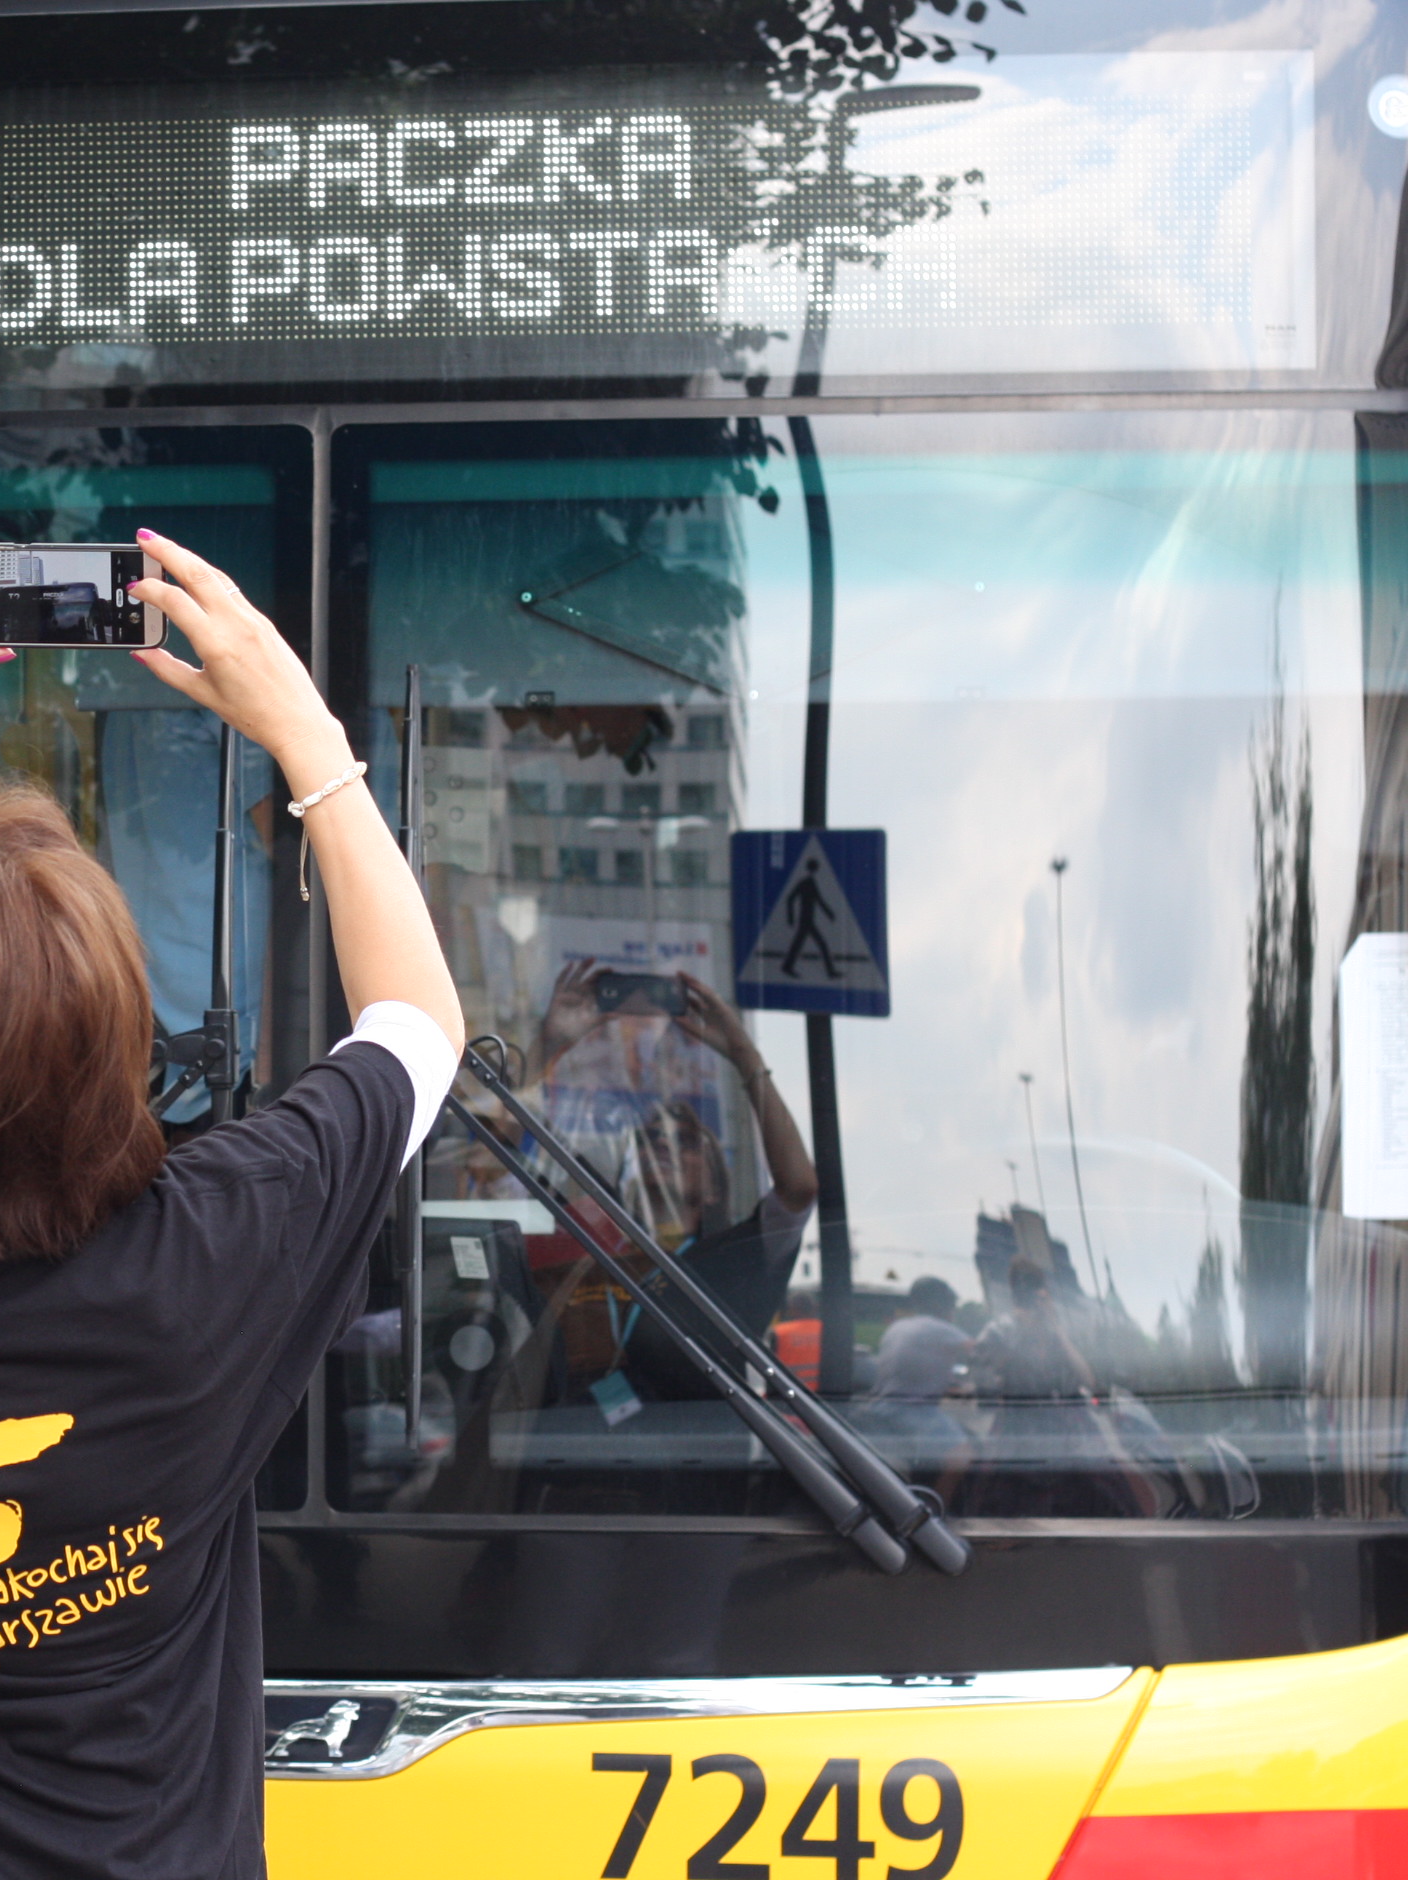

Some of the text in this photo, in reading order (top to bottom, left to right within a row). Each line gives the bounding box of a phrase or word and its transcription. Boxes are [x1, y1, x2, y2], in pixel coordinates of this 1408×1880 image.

[229, 113, 694, 211] PACZKA
[122, 1515, 164, 1557] się
[591, 1752, 965, 1880] 7249
